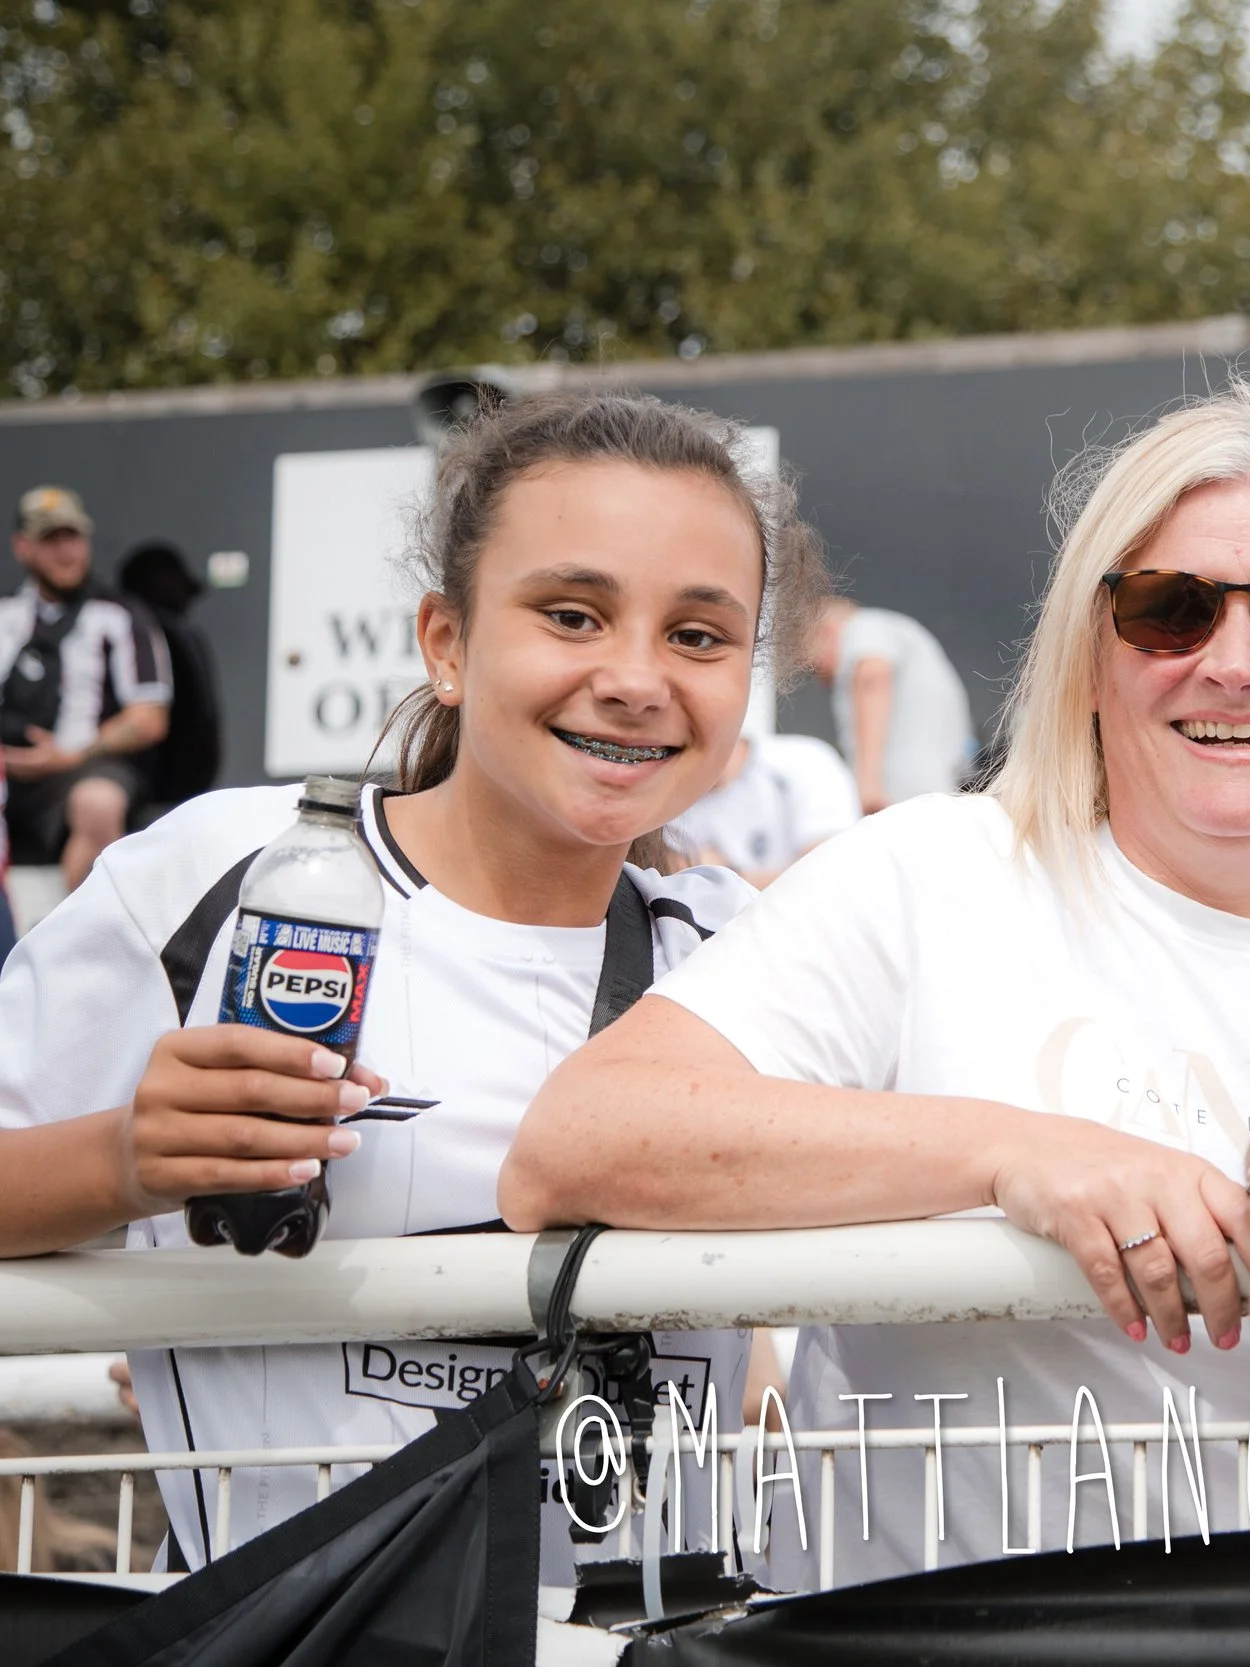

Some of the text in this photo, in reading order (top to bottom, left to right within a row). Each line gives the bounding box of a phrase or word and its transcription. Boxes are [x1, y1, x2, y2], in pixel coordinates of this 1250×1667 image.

[267, 971, 347, 999] PEPSI
[349, 963, 370, 1023] MAX
[362, 1343, 507, 1402] Design
